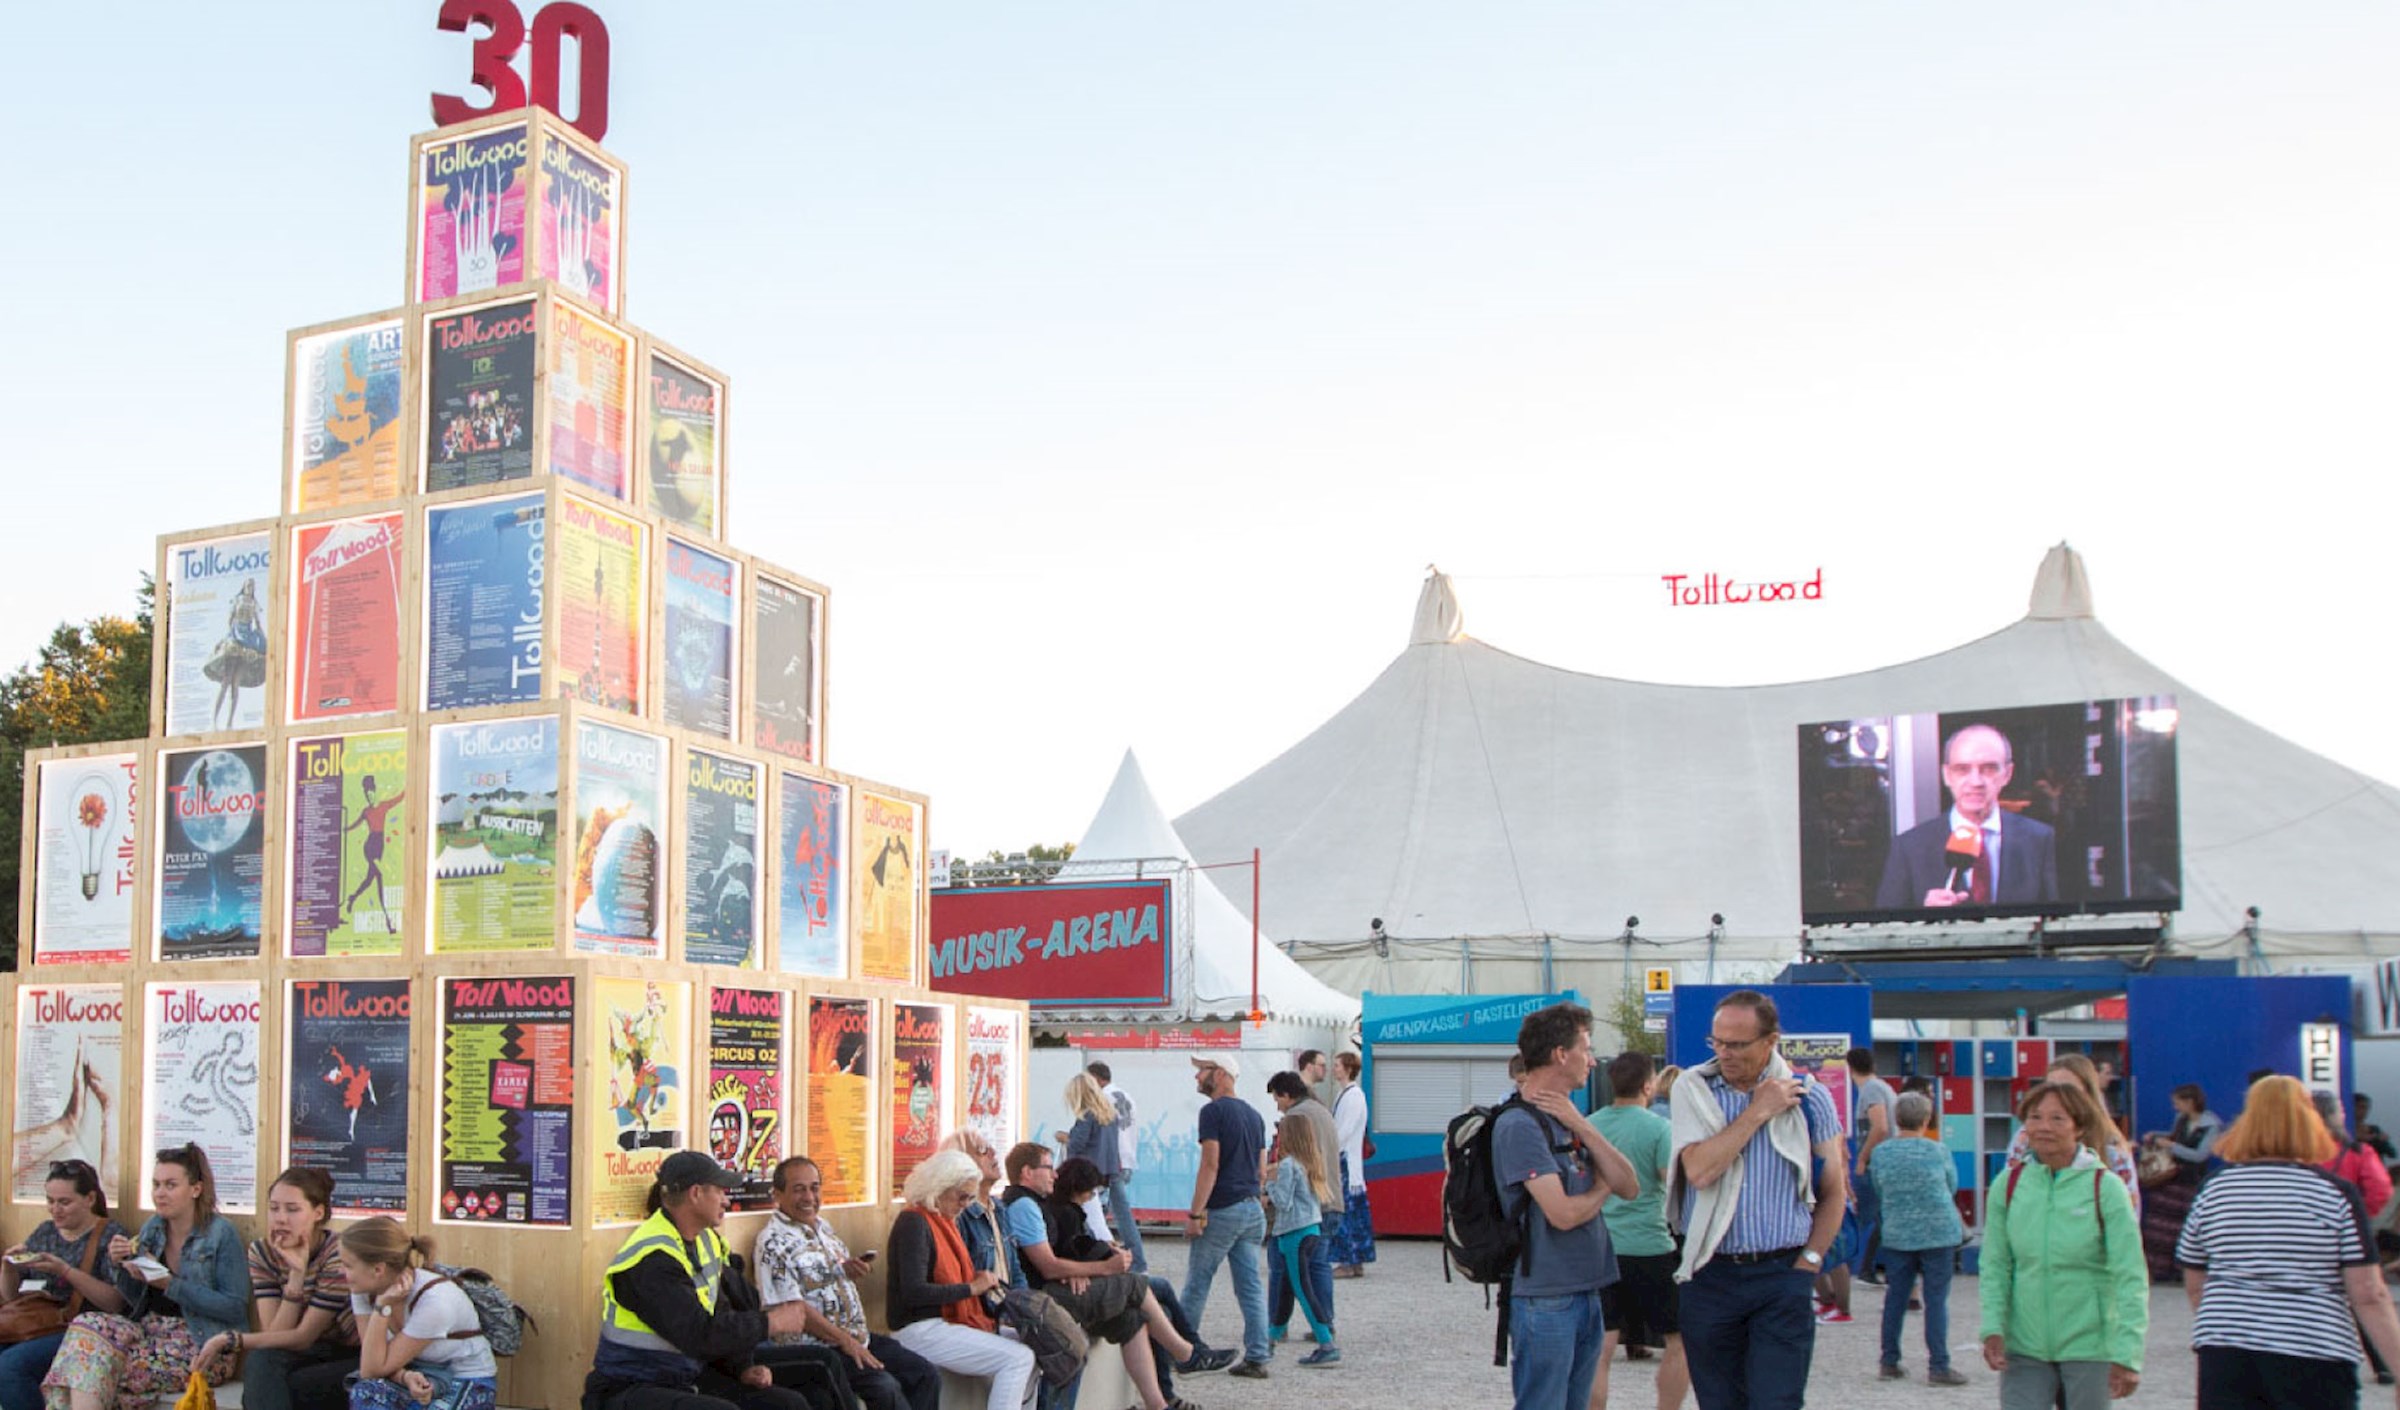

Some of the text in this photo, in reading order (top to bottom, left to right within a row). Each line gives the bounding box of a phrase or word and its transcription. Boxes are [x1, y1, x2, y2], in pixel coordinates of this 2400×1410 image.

[430, 0, 610, 144] 30
[435, 301, 537, 349] Tollwood
[667, 543, 732, 596] ollwood
[1661, 567, 1822, 606] Tollwood
[451, 723, 545, 757] Tollwood
[863, 793, 913, 833] ollwood
[930, 904, 1158, 978] MUSIK-ARENA
[758, 1048, 778, 1062] OZ
[968, 1052, 1003, 1117] 25
